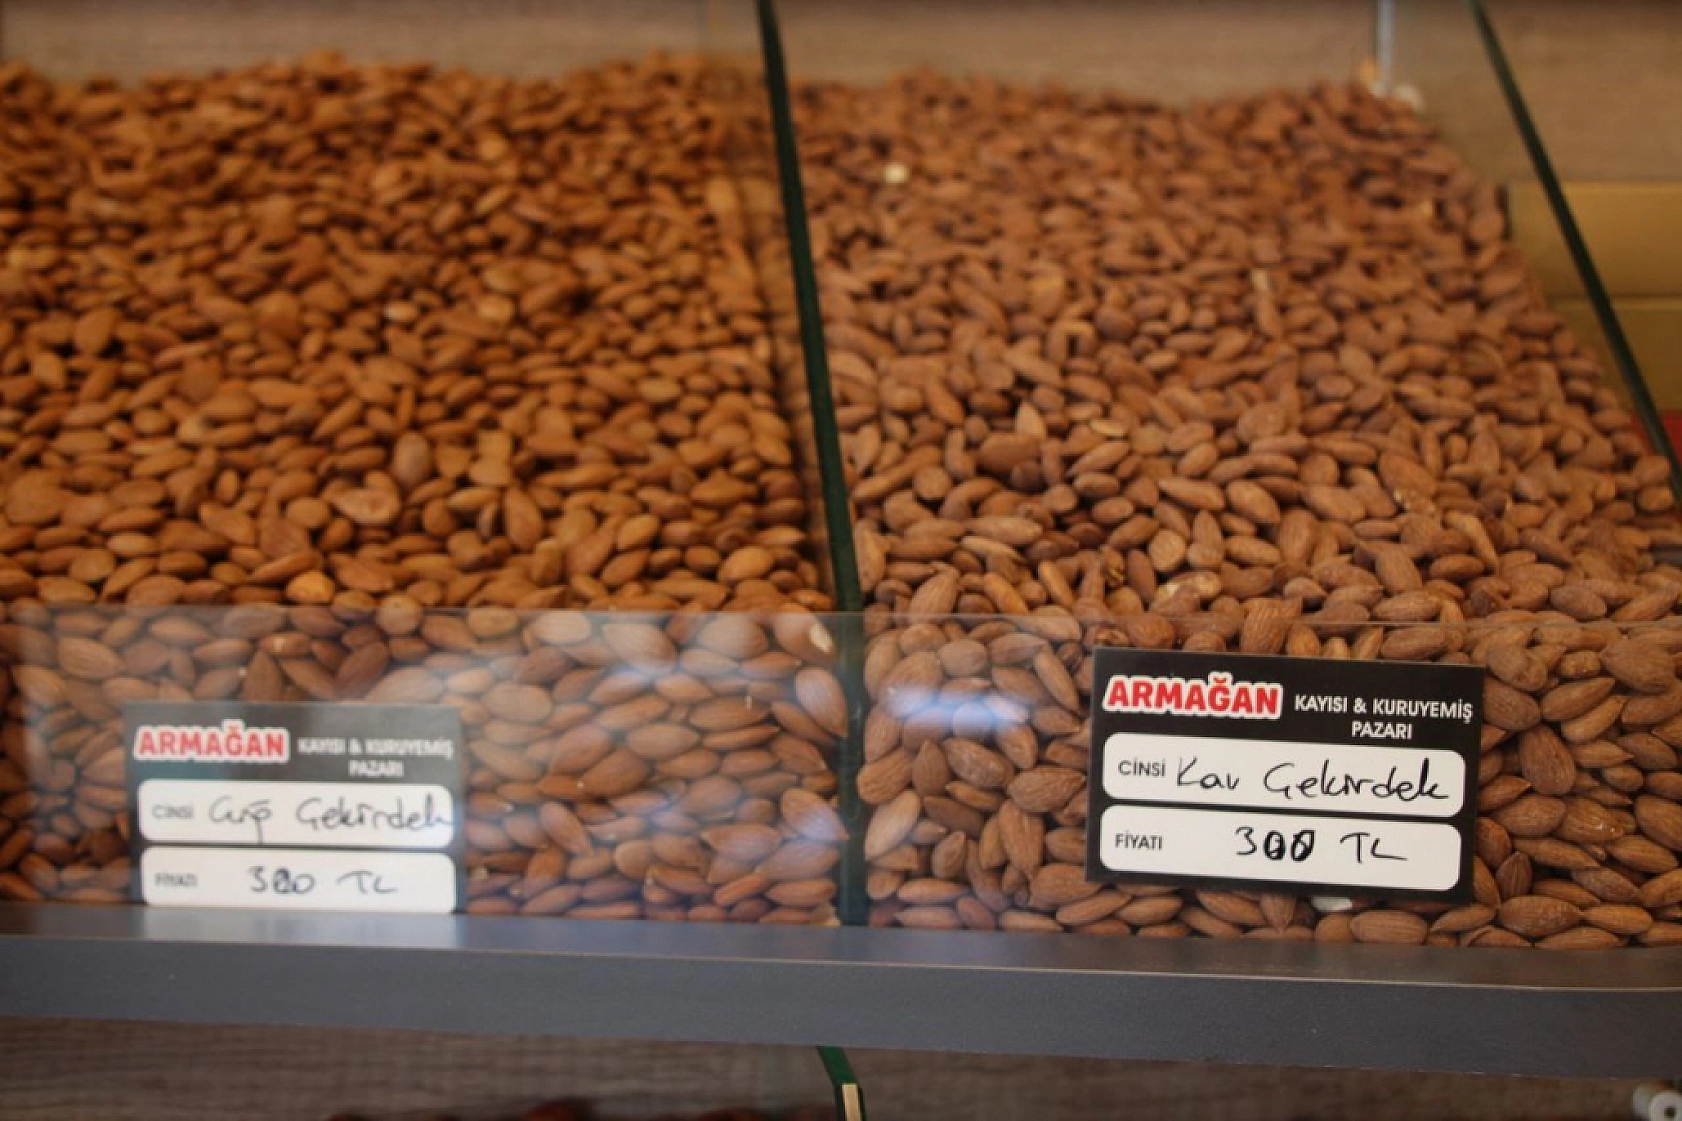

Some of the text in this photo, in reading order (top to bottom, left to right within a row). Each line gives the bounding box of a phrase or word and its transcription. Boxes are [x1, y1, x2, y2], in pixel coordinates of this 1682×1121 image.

[1105, 673, 1281, 718] ARMAĞAN
[1294, 694, 1473, 723] KAYISI & KURUYEMİŞ
[136, 721, 286, 760] ARMAĞAN
[1352, 721, 1413, 740] PAZARI
[1118, 758, 1166, 777] CİNSİ
[1115, 826, 1407, 863] FİYATI 300 TL
[337, 870, 397, 894] TL
